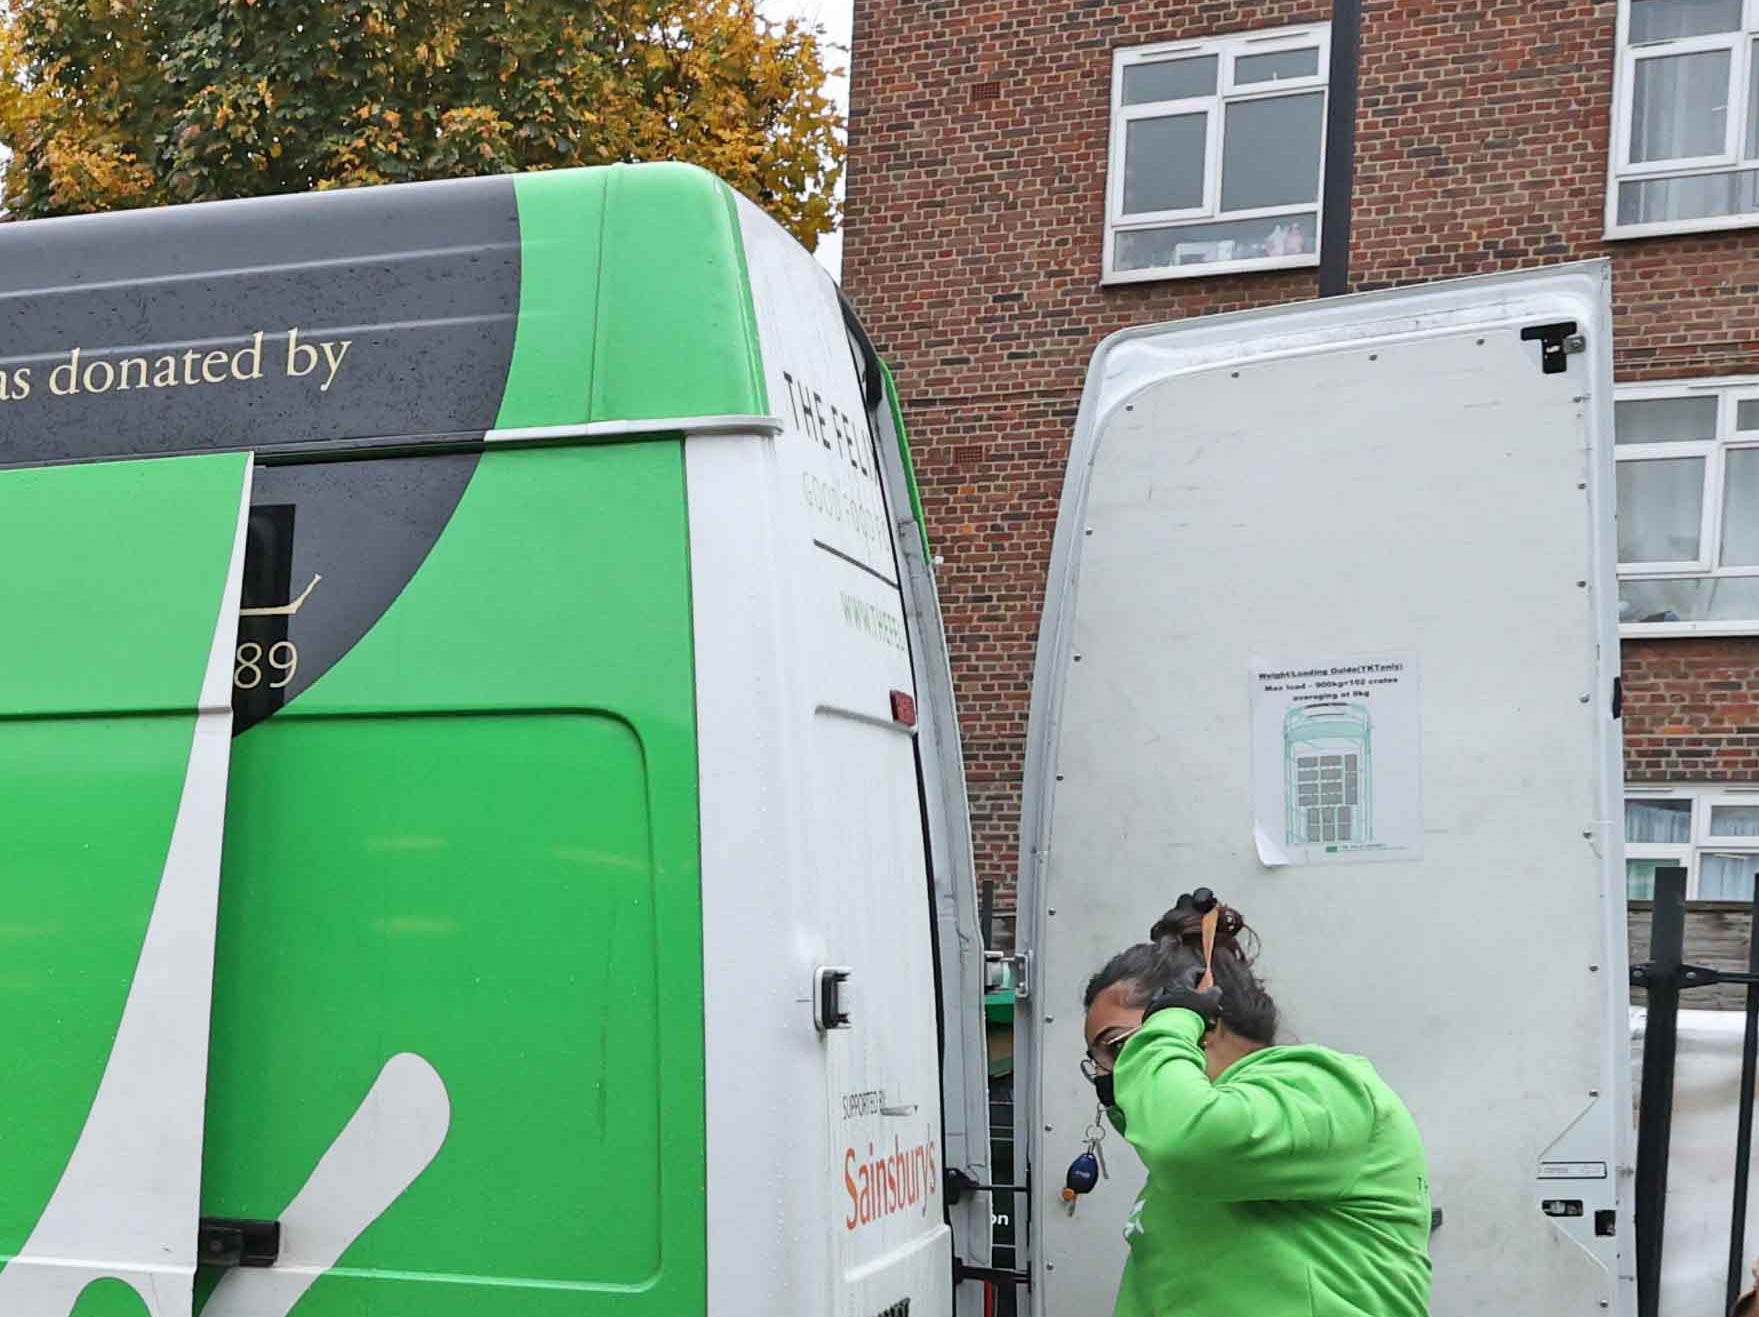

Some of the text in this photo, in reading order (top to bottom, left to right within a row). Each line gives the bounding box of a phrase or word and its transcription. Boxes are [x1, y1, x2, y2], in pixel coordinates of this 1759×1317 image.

[48, 331, 264, 396] donated
[287, 326, 352, 391] by
[783, 370, 832, 451] THE
[844, 1122, 937, 1231] Sainsbury's
